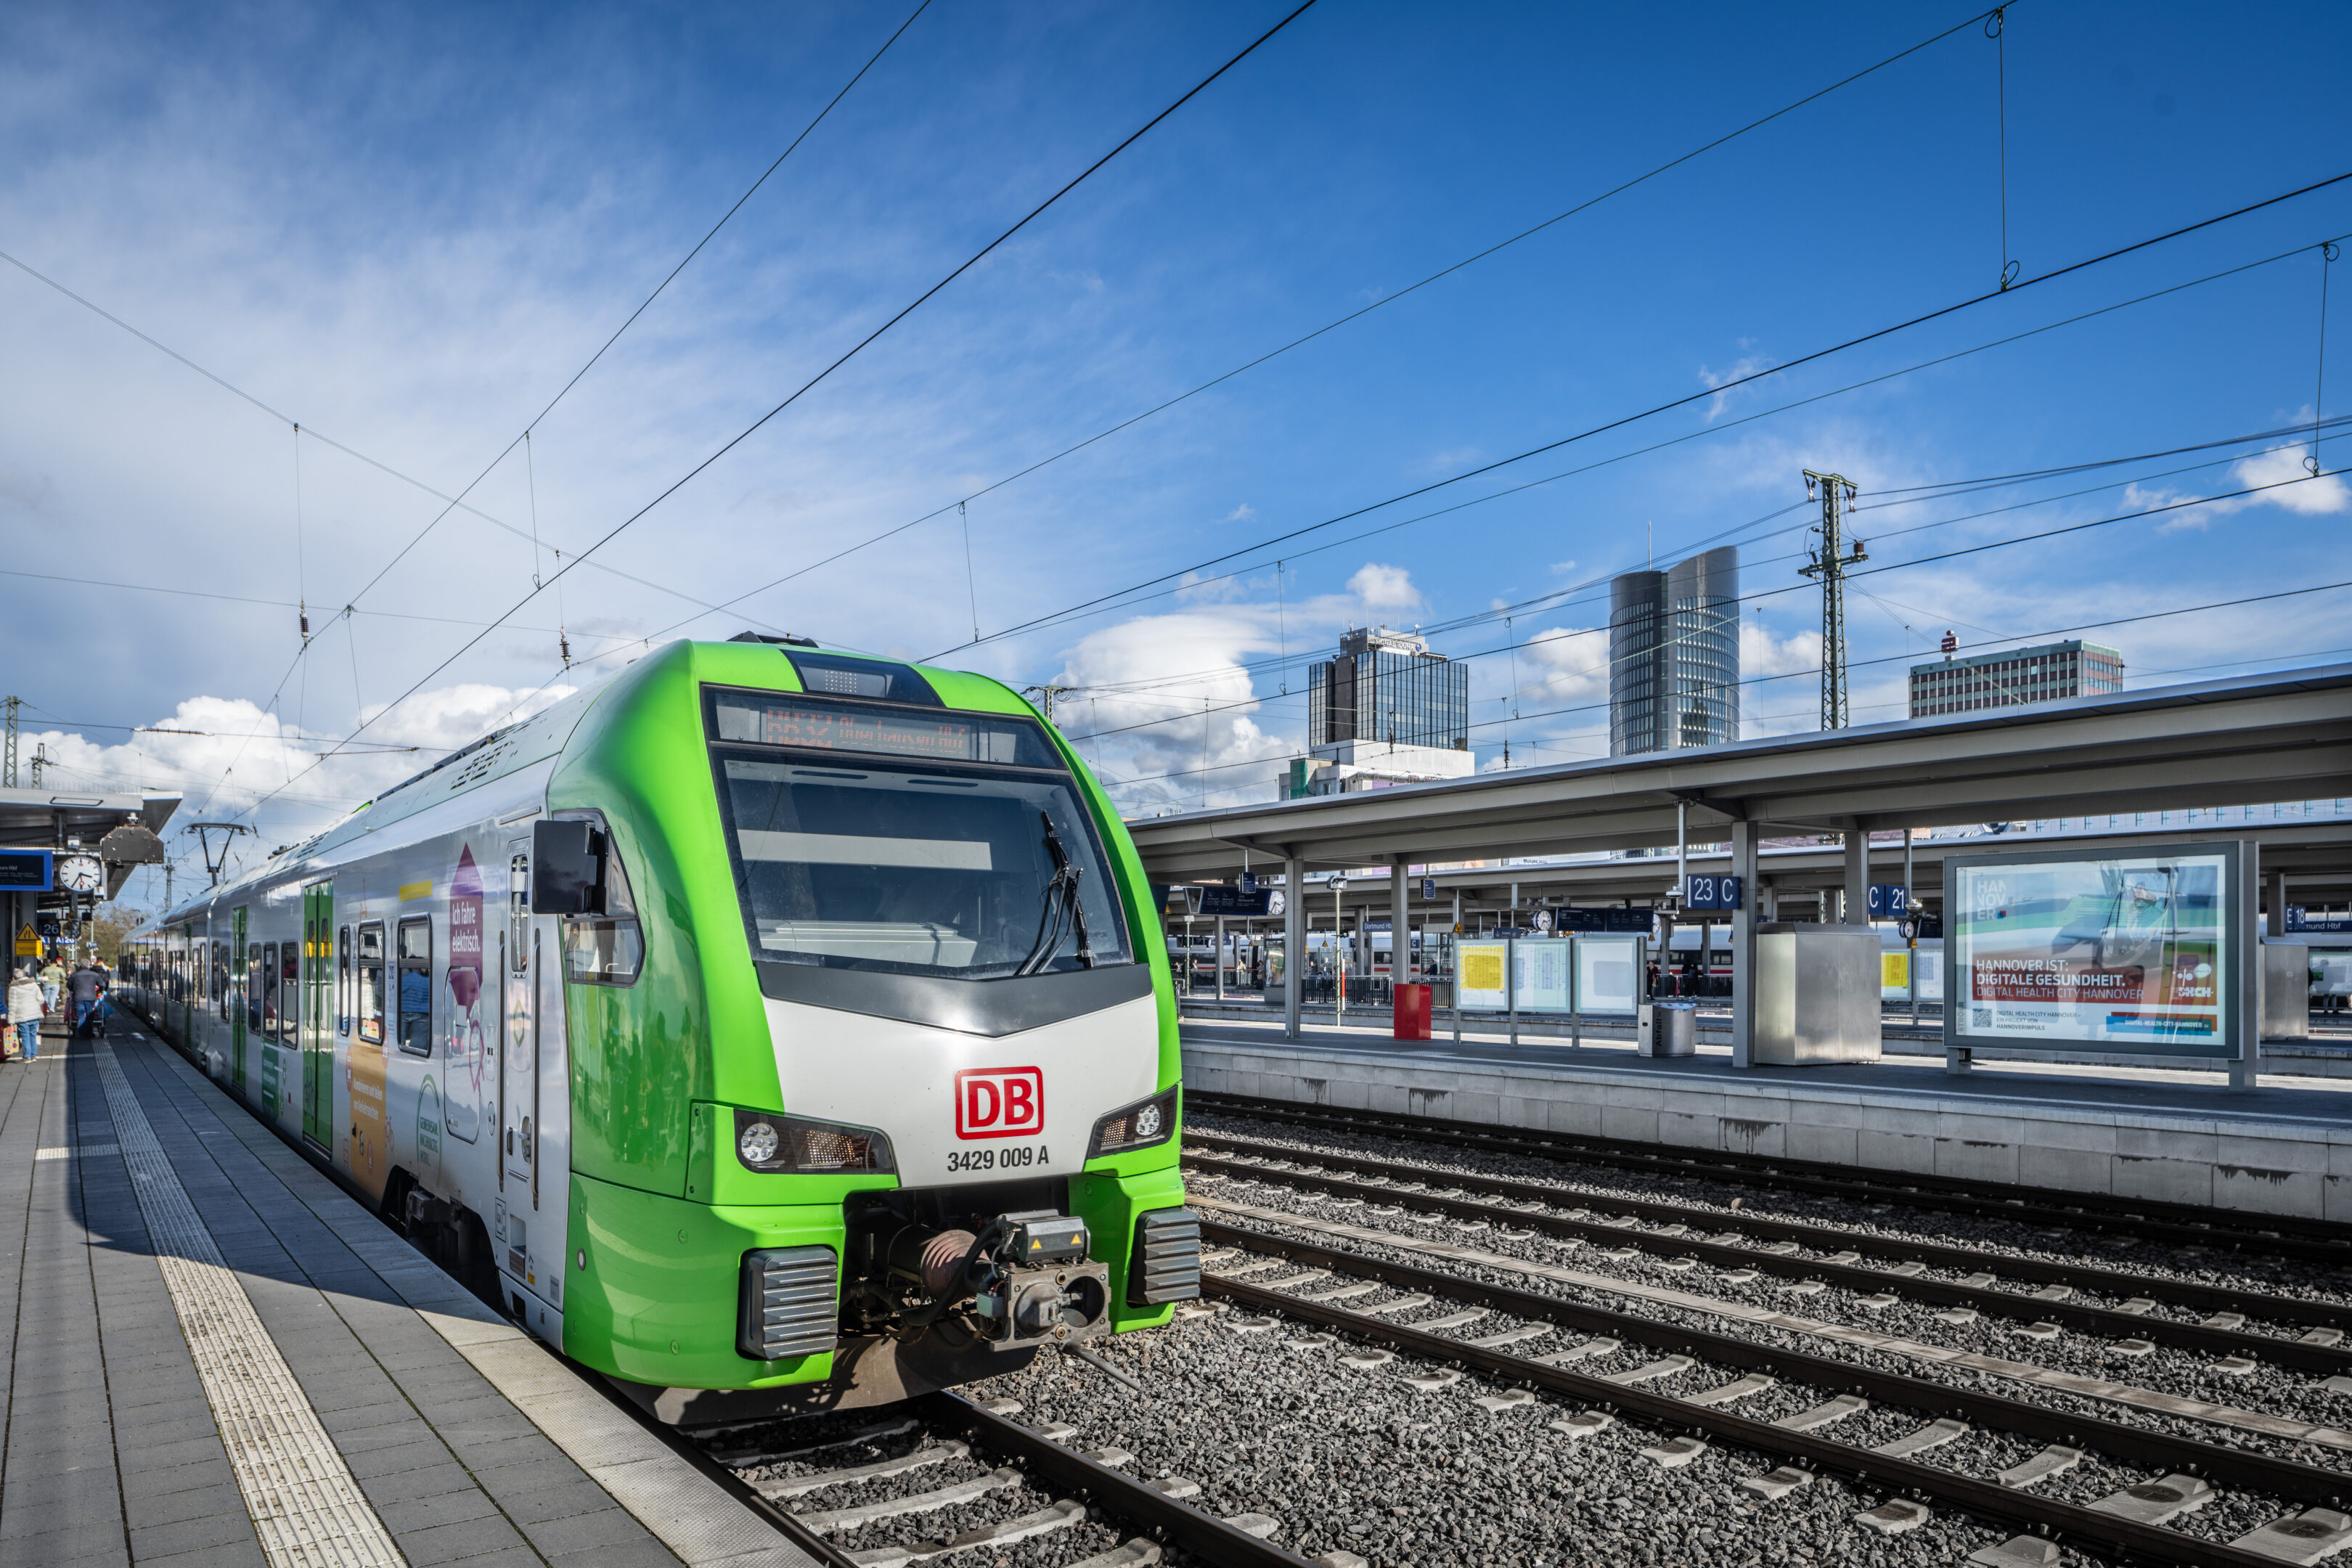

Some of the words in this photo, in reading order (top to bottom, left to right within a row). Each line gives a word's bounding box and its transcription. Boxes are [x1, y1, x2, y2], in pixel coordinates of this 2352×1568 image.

[1375, 638, 1395, 647] SIGNAL
[1694, 878, 1712, 901] 23
[1722, 878, 1733, 902] C
[1869, 886, 1879, 907] C
[1892, 888, 1904, 909] 21
[461, 901, 475, 924] fahre
[2287, 908, 2292, 923] E
[2296, 908, 2305, 923] 18
[44, 924, 58, 934] 26
[452, 928, 481, 952] elektrisch.
[1976, 959, 2043, 971] HANNOVER
[2046, 960, 2068, 971] IST:
[1977, 973, 2033, 985] DIGITALE
[2035, 974, 2126, 987] GESUNDHEIT.
[1977, 987, 2013, 997] DIGITAL
[2016, 987, 2054, 998] HEALTH
[2057, 988, 2081, 999] CITY
[2083, 989, 2144, 1000] HANNOVER
[967, 1078, 1034, 1127] DB
[947, 1150, 995, 1172] 3429
[1000, 1146, 1033, 1168] 009
[1037, 1145, 1050, 1165] A
